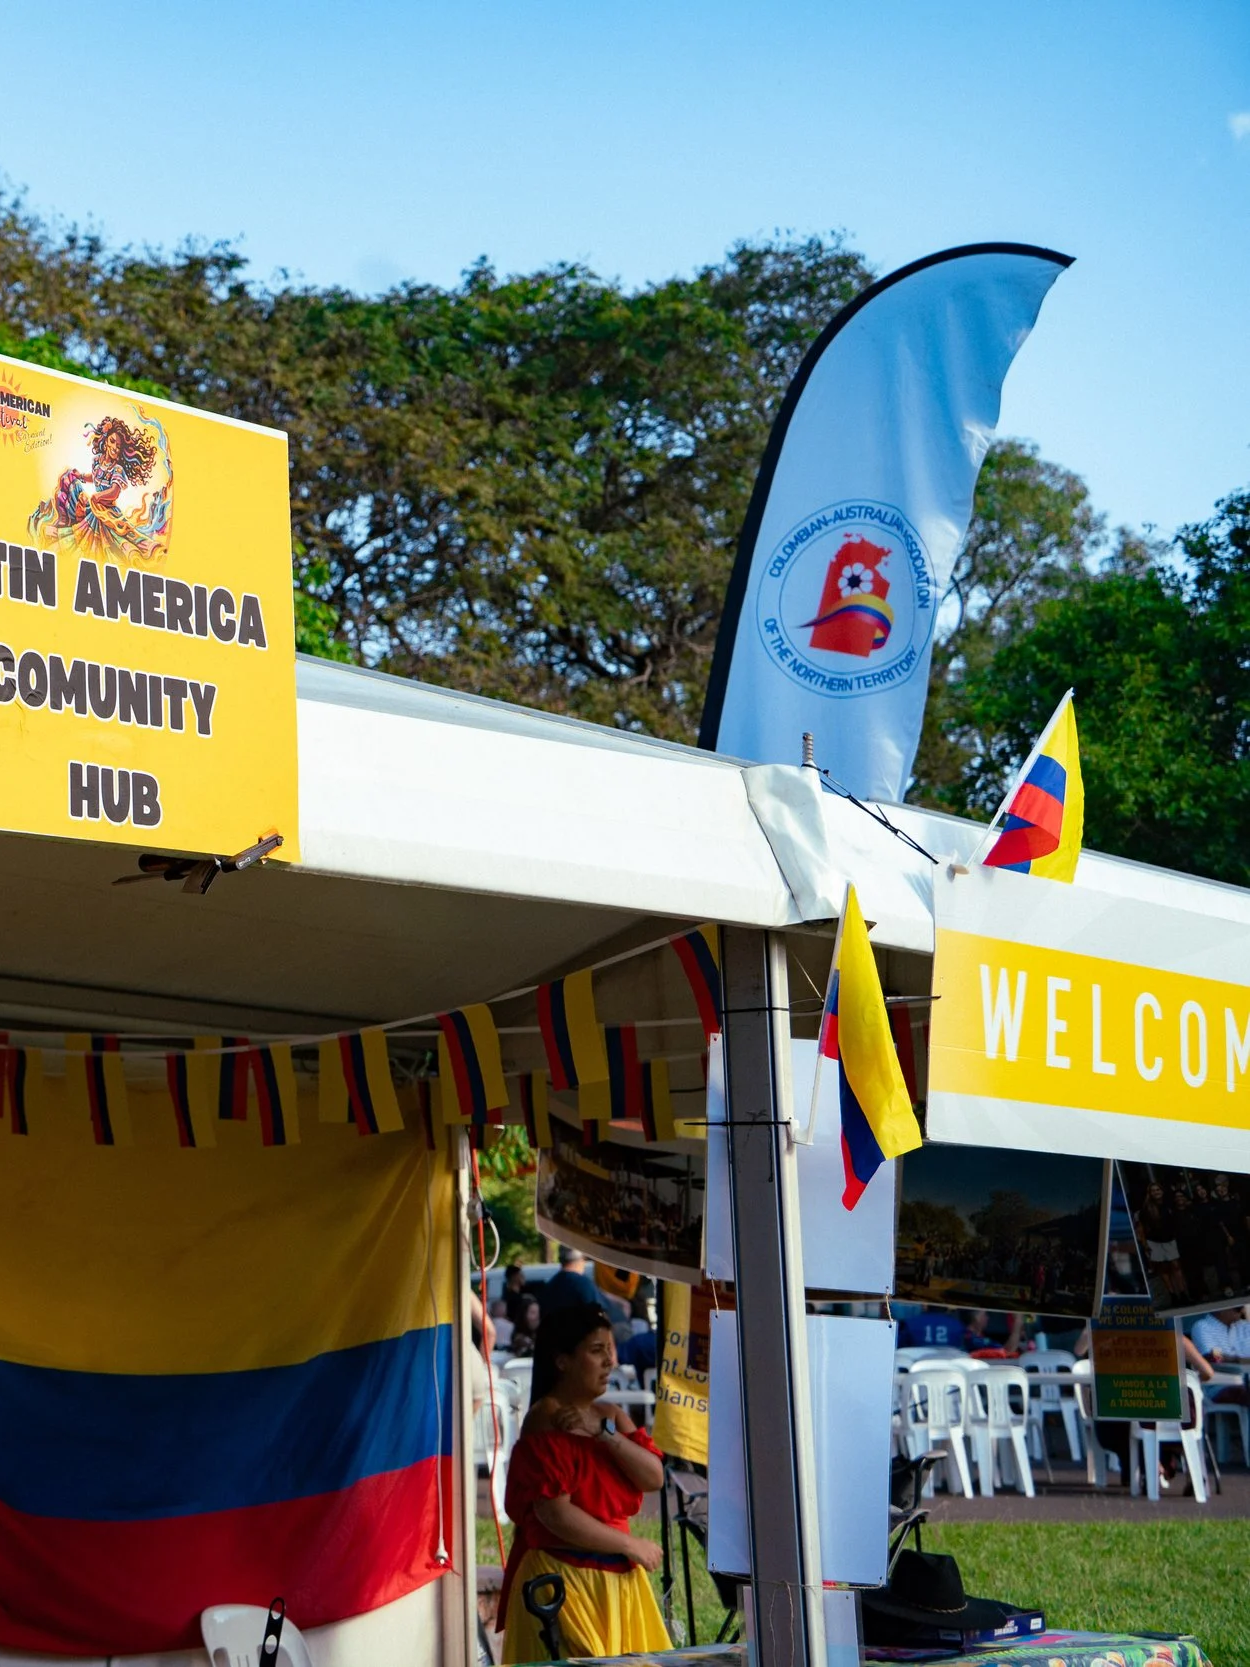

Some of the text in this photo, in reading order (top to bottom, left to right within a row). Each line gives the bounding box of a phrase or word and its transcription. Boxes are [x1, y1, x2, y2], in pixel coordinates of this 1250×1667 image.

[73, 560, 268, 650] AMERICA
[764, 617, 917, 692] OF THE NORTHERN TERRITORY
[68, 761, 163, 827] HUB
[924, 1324, 948, 1343] 12
